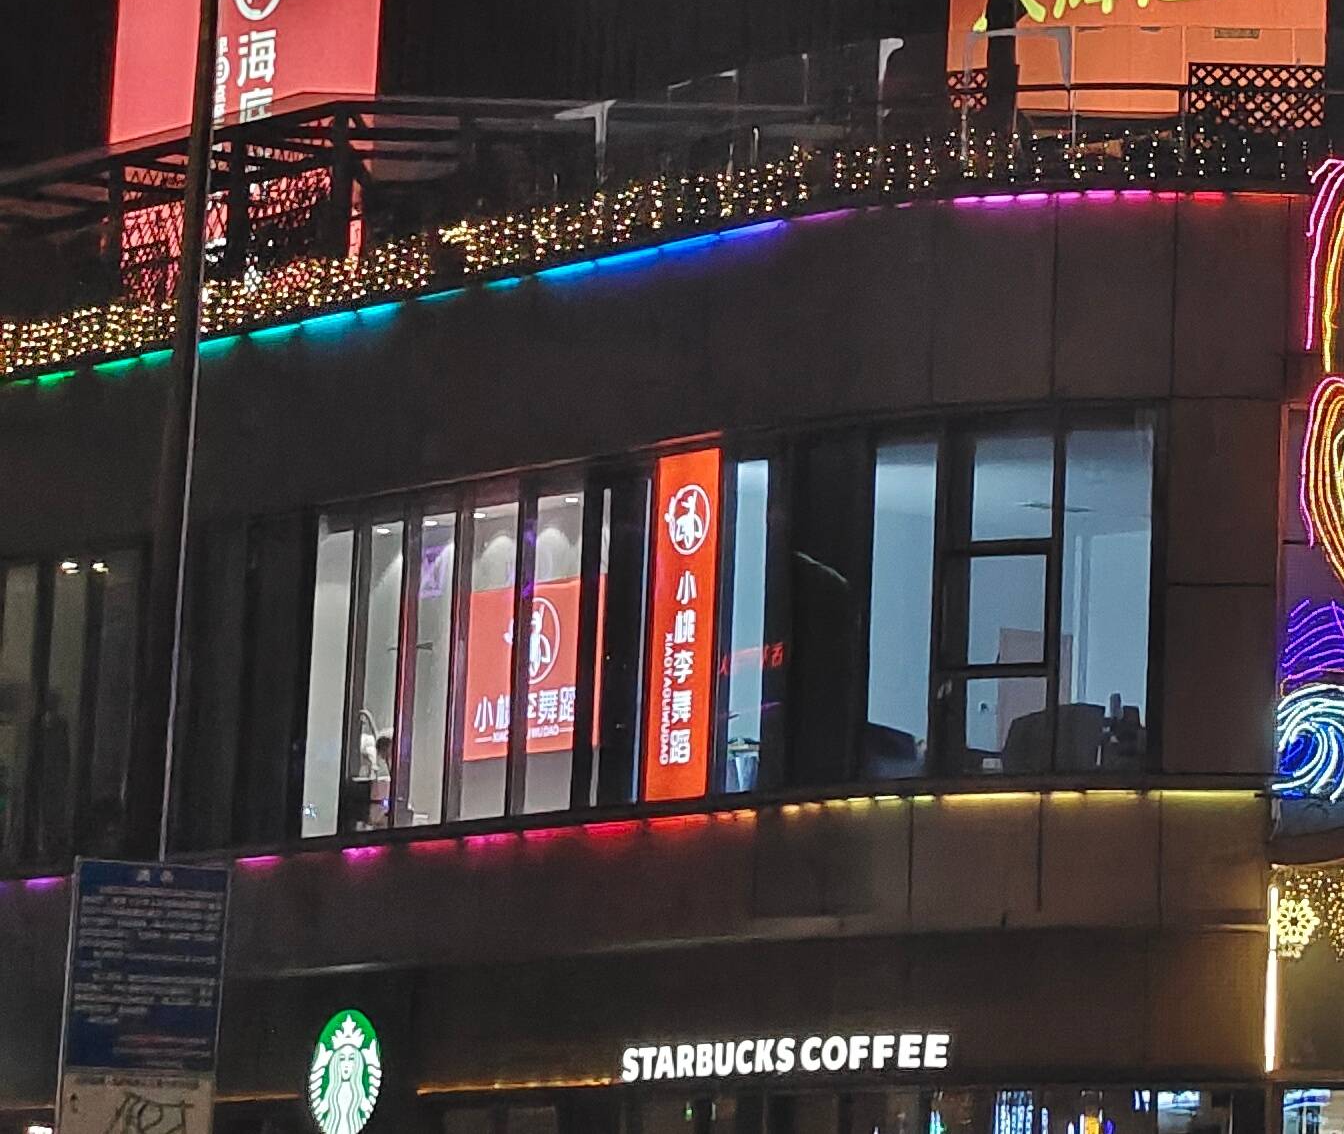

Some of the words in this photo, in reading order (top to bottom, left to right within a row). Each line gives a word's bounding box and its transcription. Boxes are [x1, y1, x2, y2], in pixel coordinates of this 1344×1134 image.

[669, 570, 698, 765] 小桃李舞蹈
[621, 1036, 797, 1084] STARBUCKS
[799, 1033, 951, 1071] COFFEE
